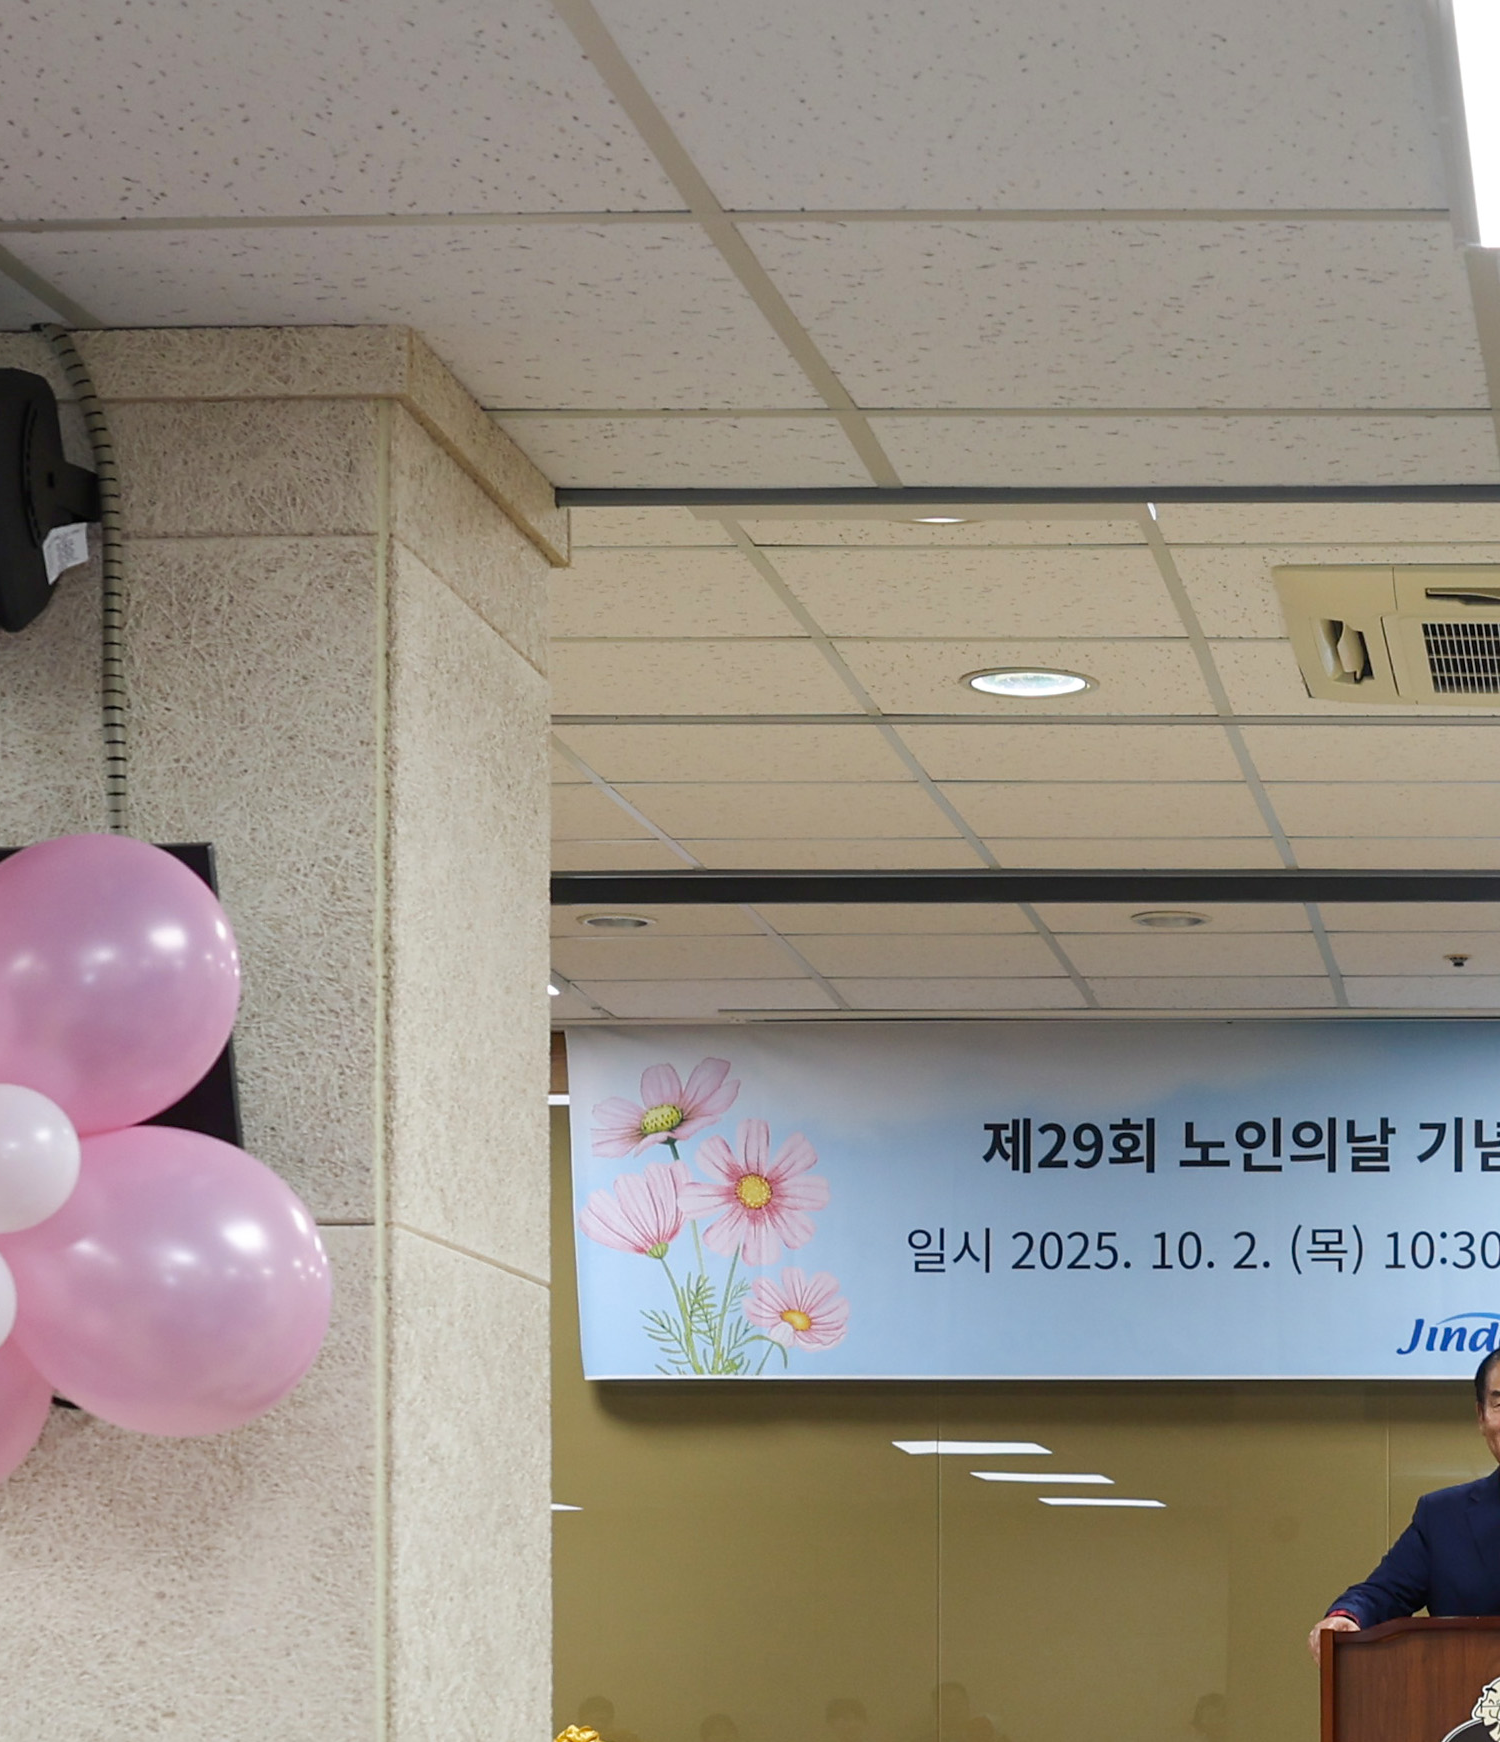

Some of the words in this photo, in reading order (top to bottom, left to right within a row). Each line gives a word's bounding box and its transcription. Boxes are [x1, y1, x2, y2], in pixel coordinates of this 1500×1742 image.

[982, 1117, 1155, 1173] 제29회
[1179, 1116, 1396, 1173] 노인의날
[907, 1227, 990, 1273] 일시
[1011, 1231, 1131, 1269] 2025.
[1152, 1231, 1215, 1269] 10.
[1233, 1231, 1270, 1269] 2.
[1291, 1225, 1363, 1275] (목)
